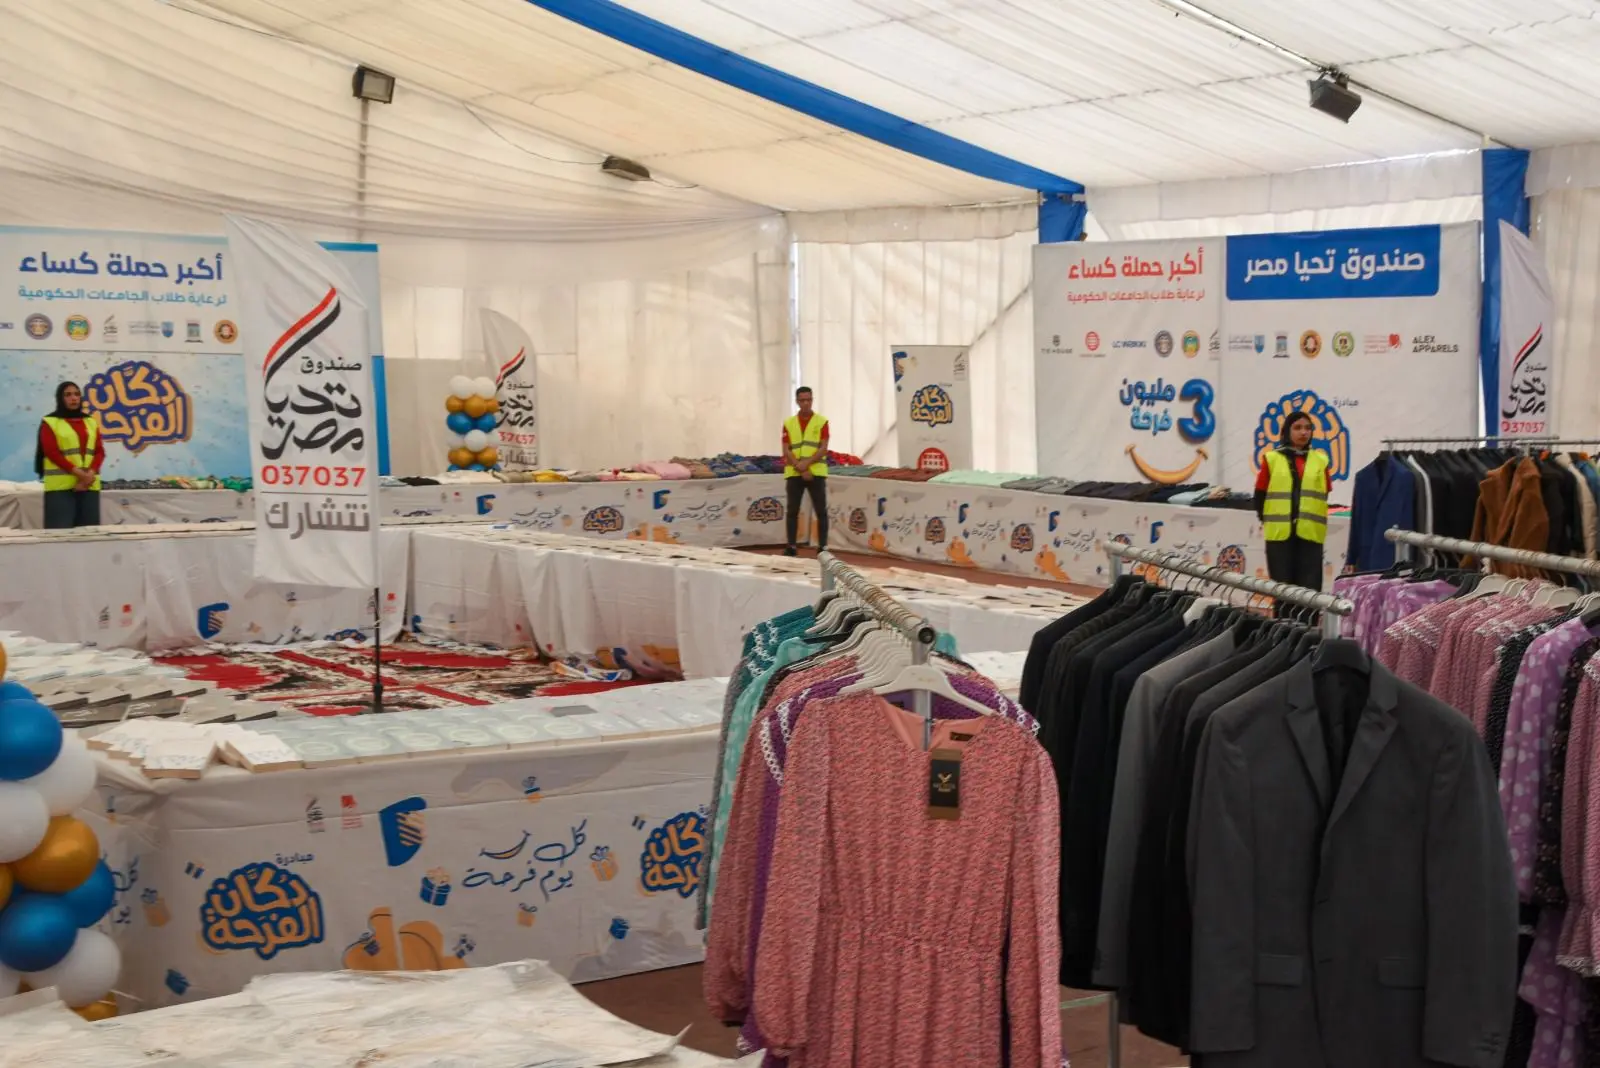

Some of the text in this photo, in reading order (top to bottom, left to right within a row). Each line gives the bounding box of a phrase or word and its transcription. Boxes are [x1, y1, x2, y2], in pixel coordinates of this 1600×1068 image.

[19, 251, 223, 285] أكبر حملة كساء
[1068, 247, 1204, 281] أكبر حملة كساء
[1244, 248, 1425, 284] صندوق تحيا مصر
[18, 285, 228, 307] لرعاية طلاب الجامعات الحكومية
[1412, 335, 1436, 344] ALEX
[1412, 343, 1460, 353] APPARELS
[301, 355, 363, 374] صندوق
[1119, 378, 1176, 407] مليون
[1131, 405, 1173, 437] فرحة
[1177, 378, 1216, 444] 3
[260, 416, 364, 461] مصر
[260, 464, 367, 488] 037037
[263, 498, 370, 540] نتشارك
[649, 816, 704, 862] كان
[275, 852, 315, 866] مبادرة
[462, 859, 537, 893] فرحة
